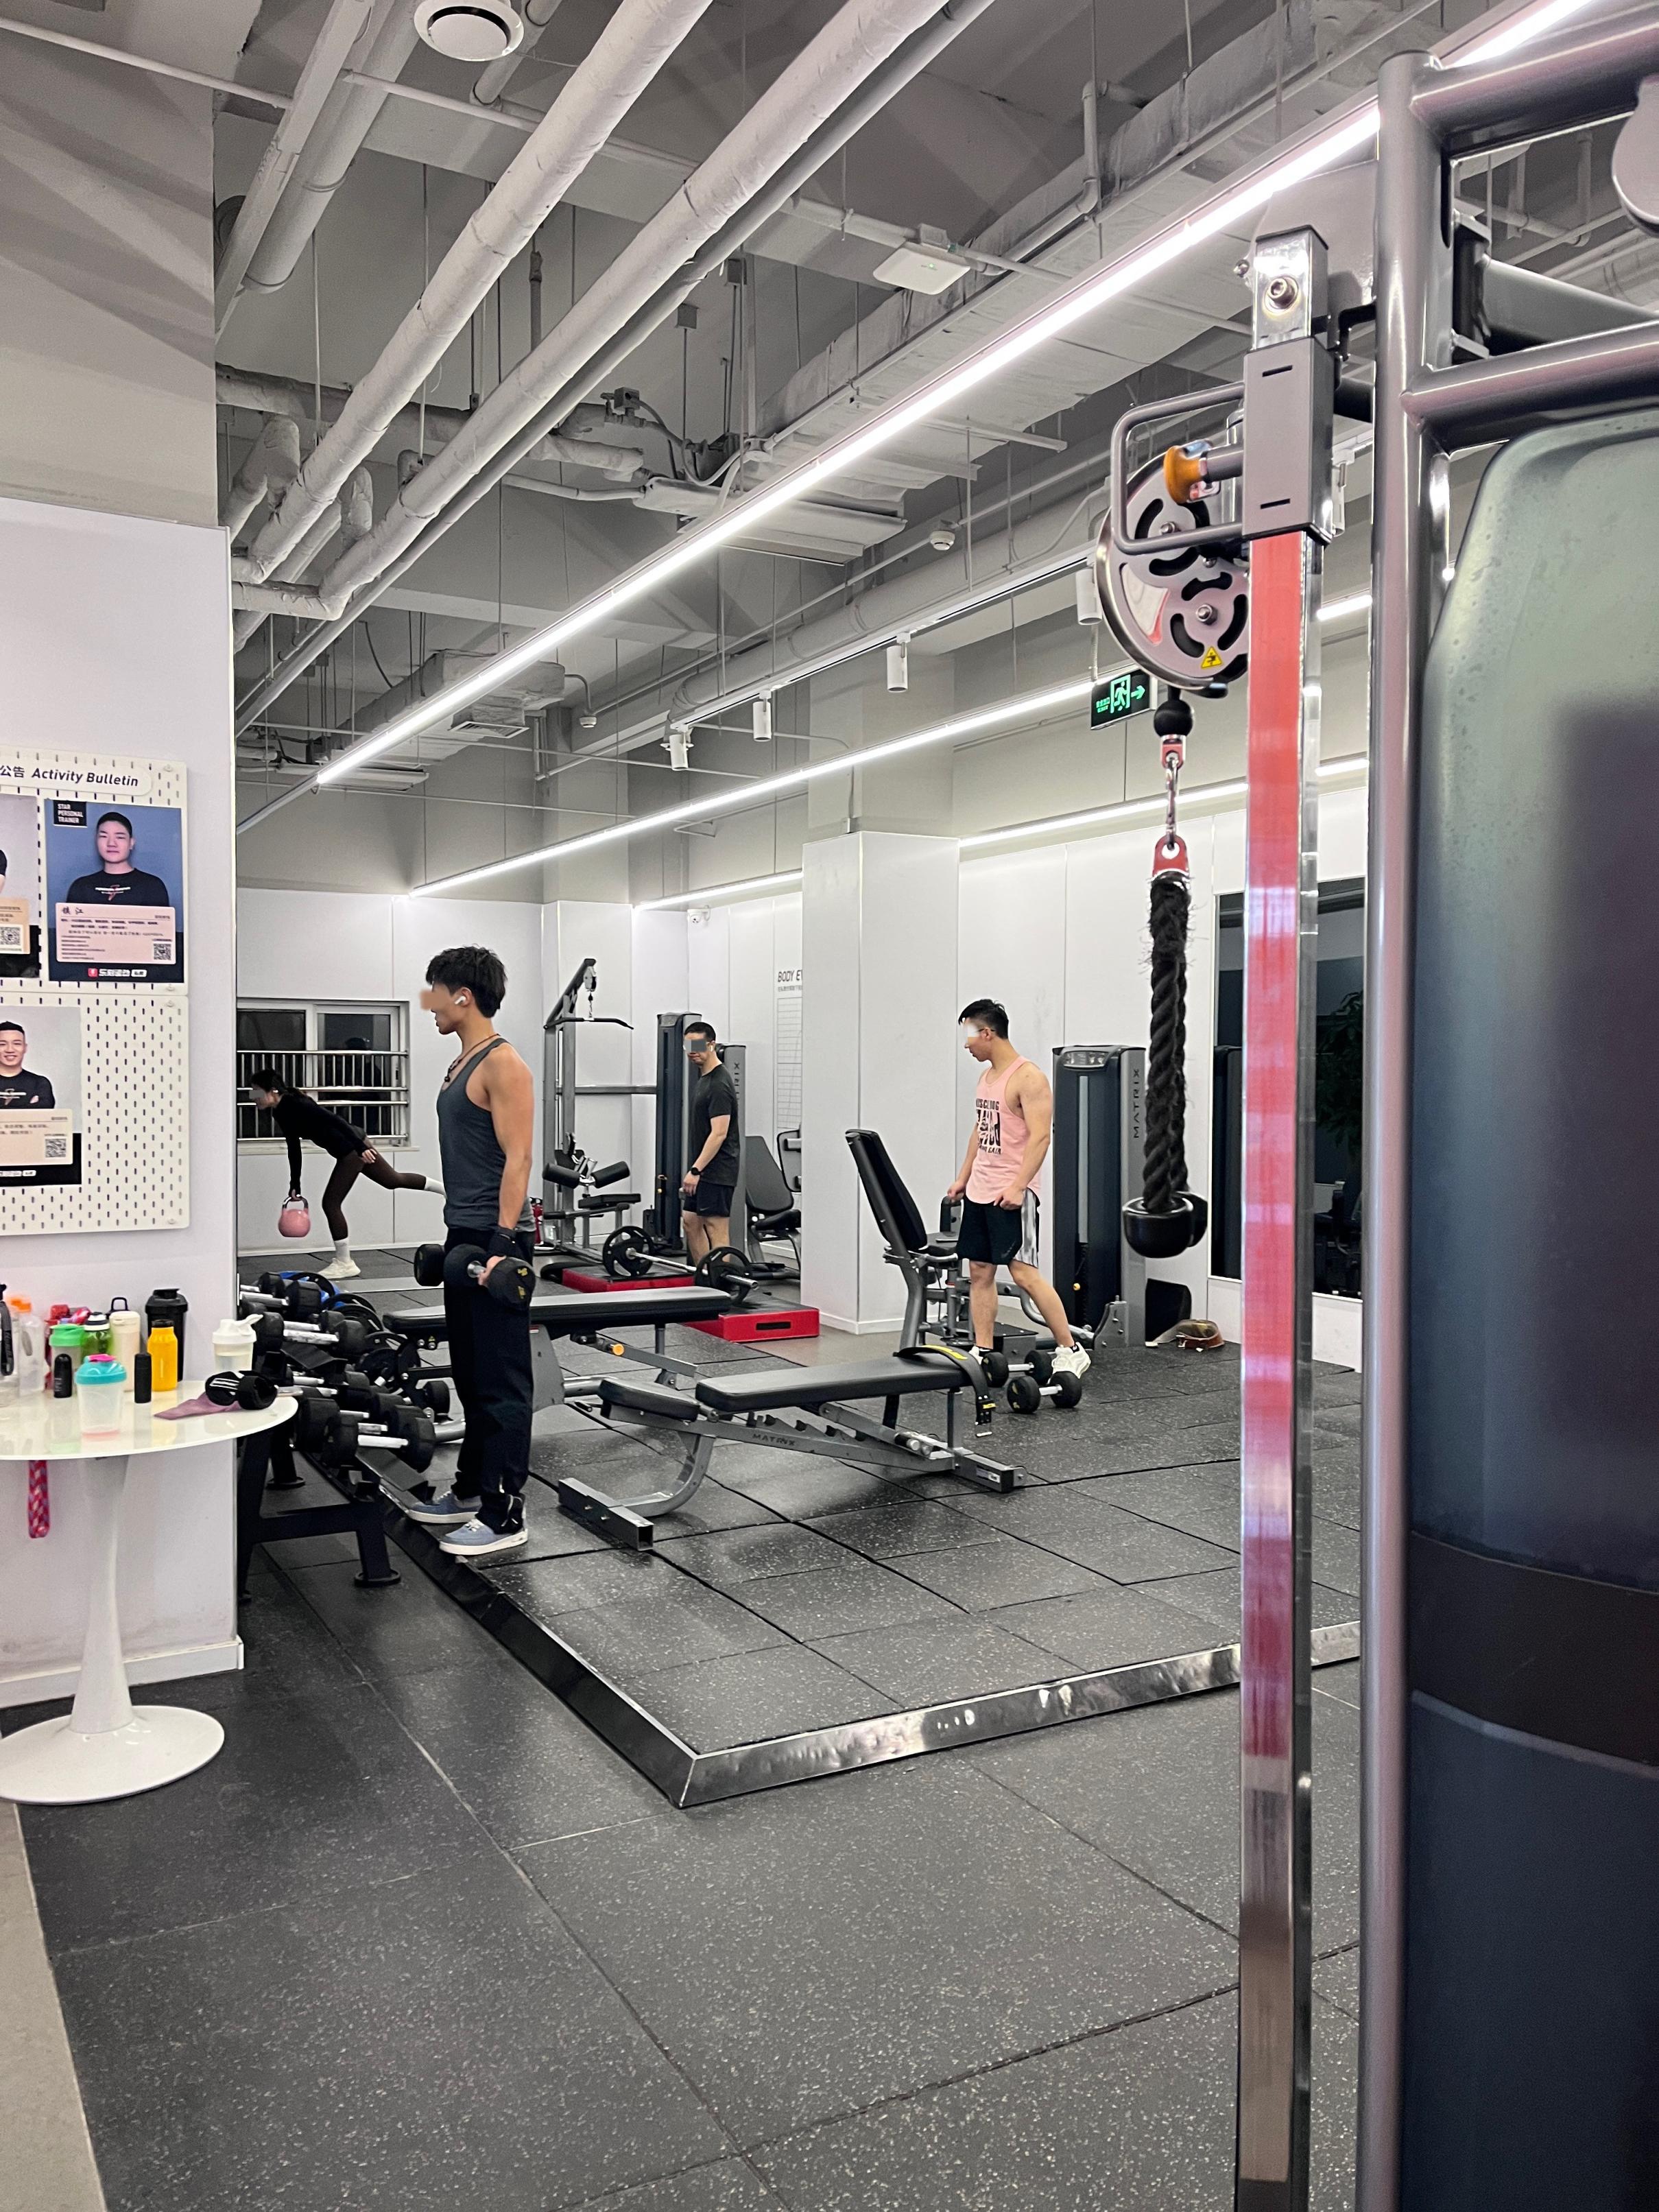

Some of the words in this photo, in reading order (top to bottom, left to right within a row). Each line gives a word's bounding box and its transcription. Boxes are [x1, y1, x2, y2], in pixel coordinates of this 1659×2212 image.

[0, 765, 25, 778] 公告
[32, 768, 83, 784] Activity
[86, 772, 138, 787] Bulletin
[777, 971, 795, 982] BODY
